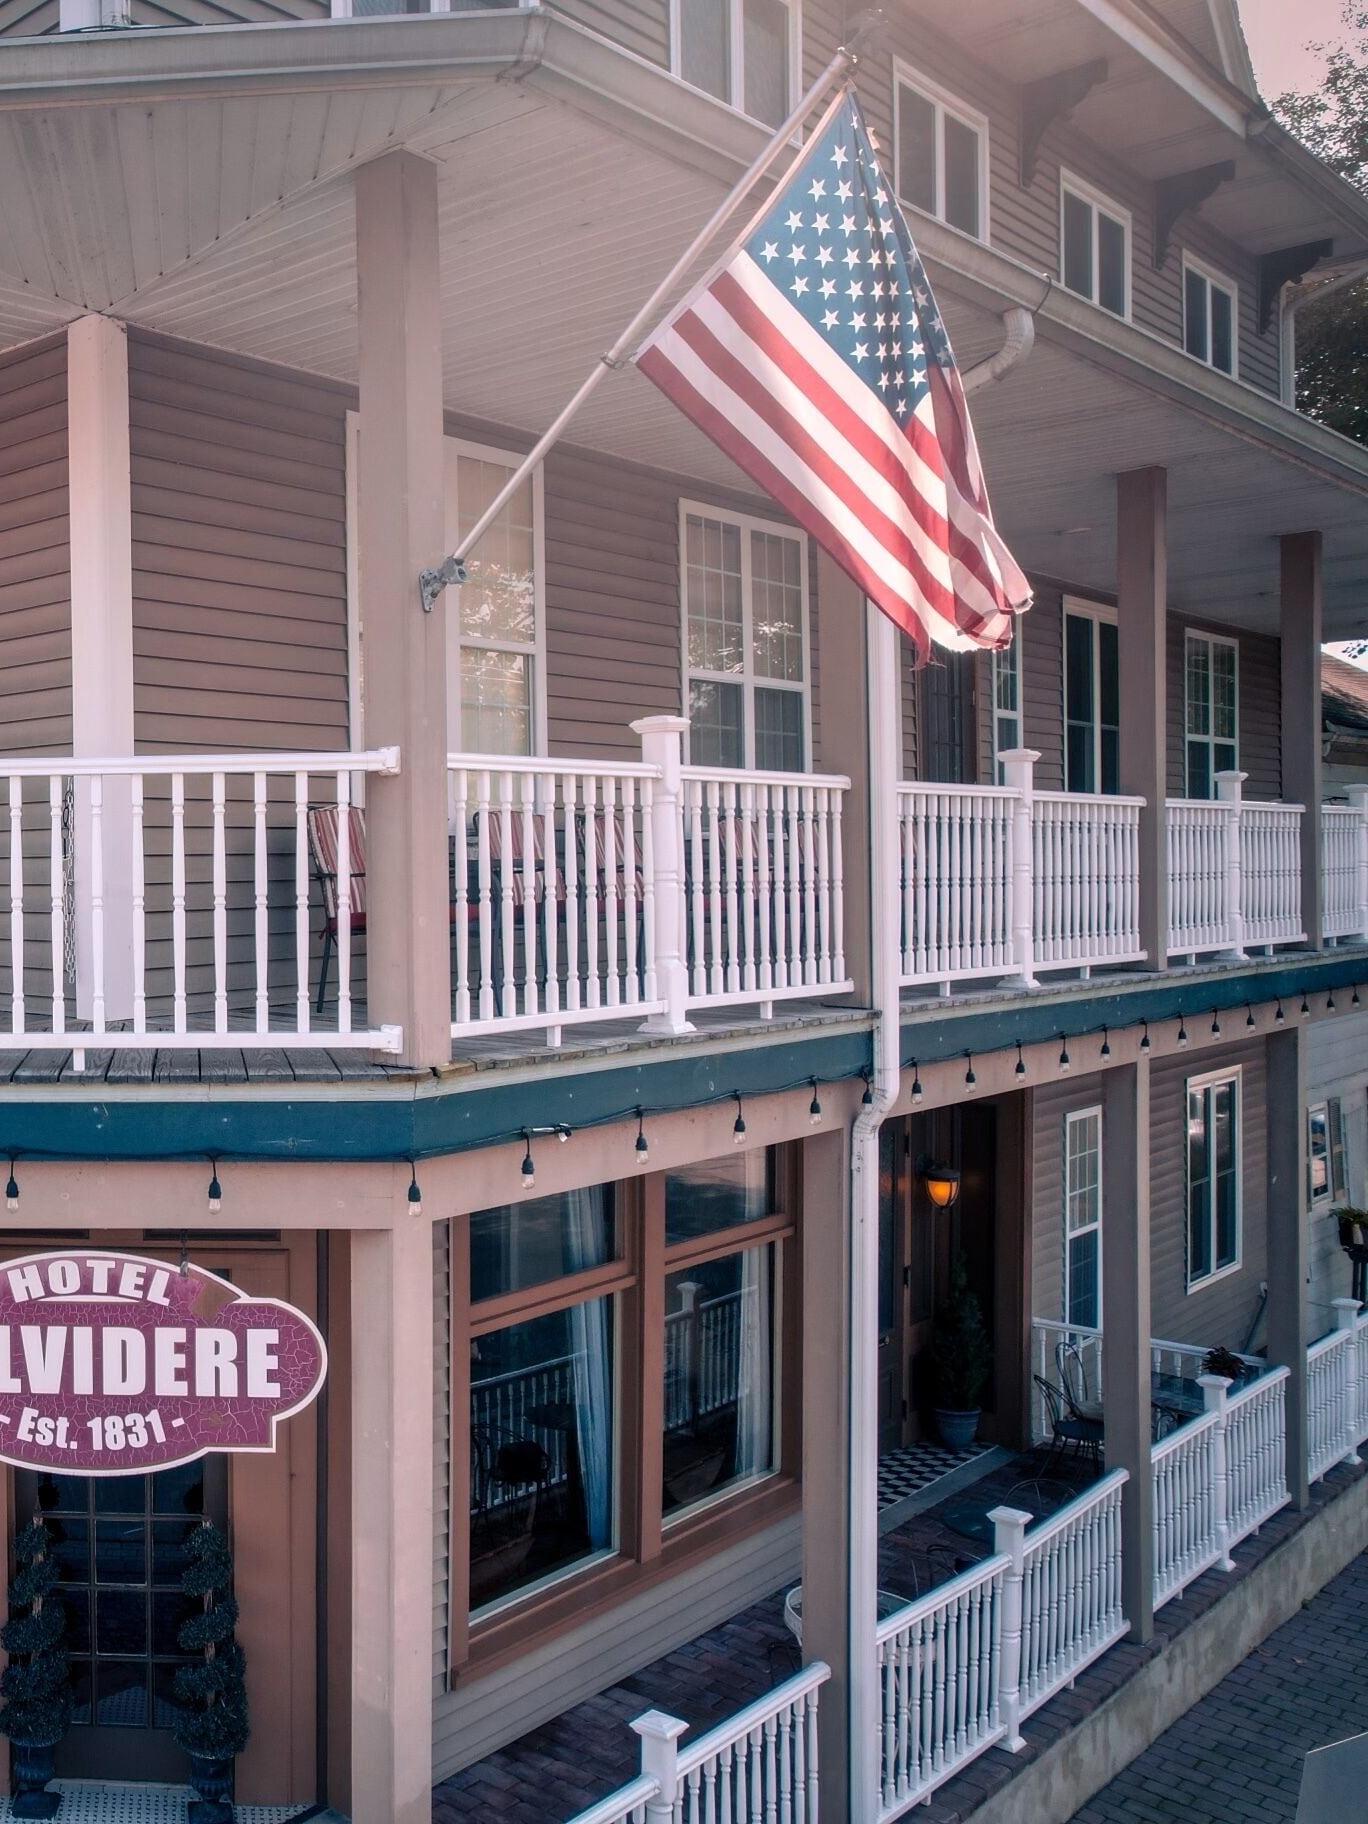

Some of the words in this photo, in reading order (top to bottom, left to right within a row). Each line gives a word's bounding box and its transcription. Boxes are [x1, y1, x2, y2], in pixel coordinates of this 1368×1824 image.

[6, 1259, 171, 1306] HOTEL
[17, 1406, 78, 1450] Est.
[87, 1408, 167, 1451] 1831
